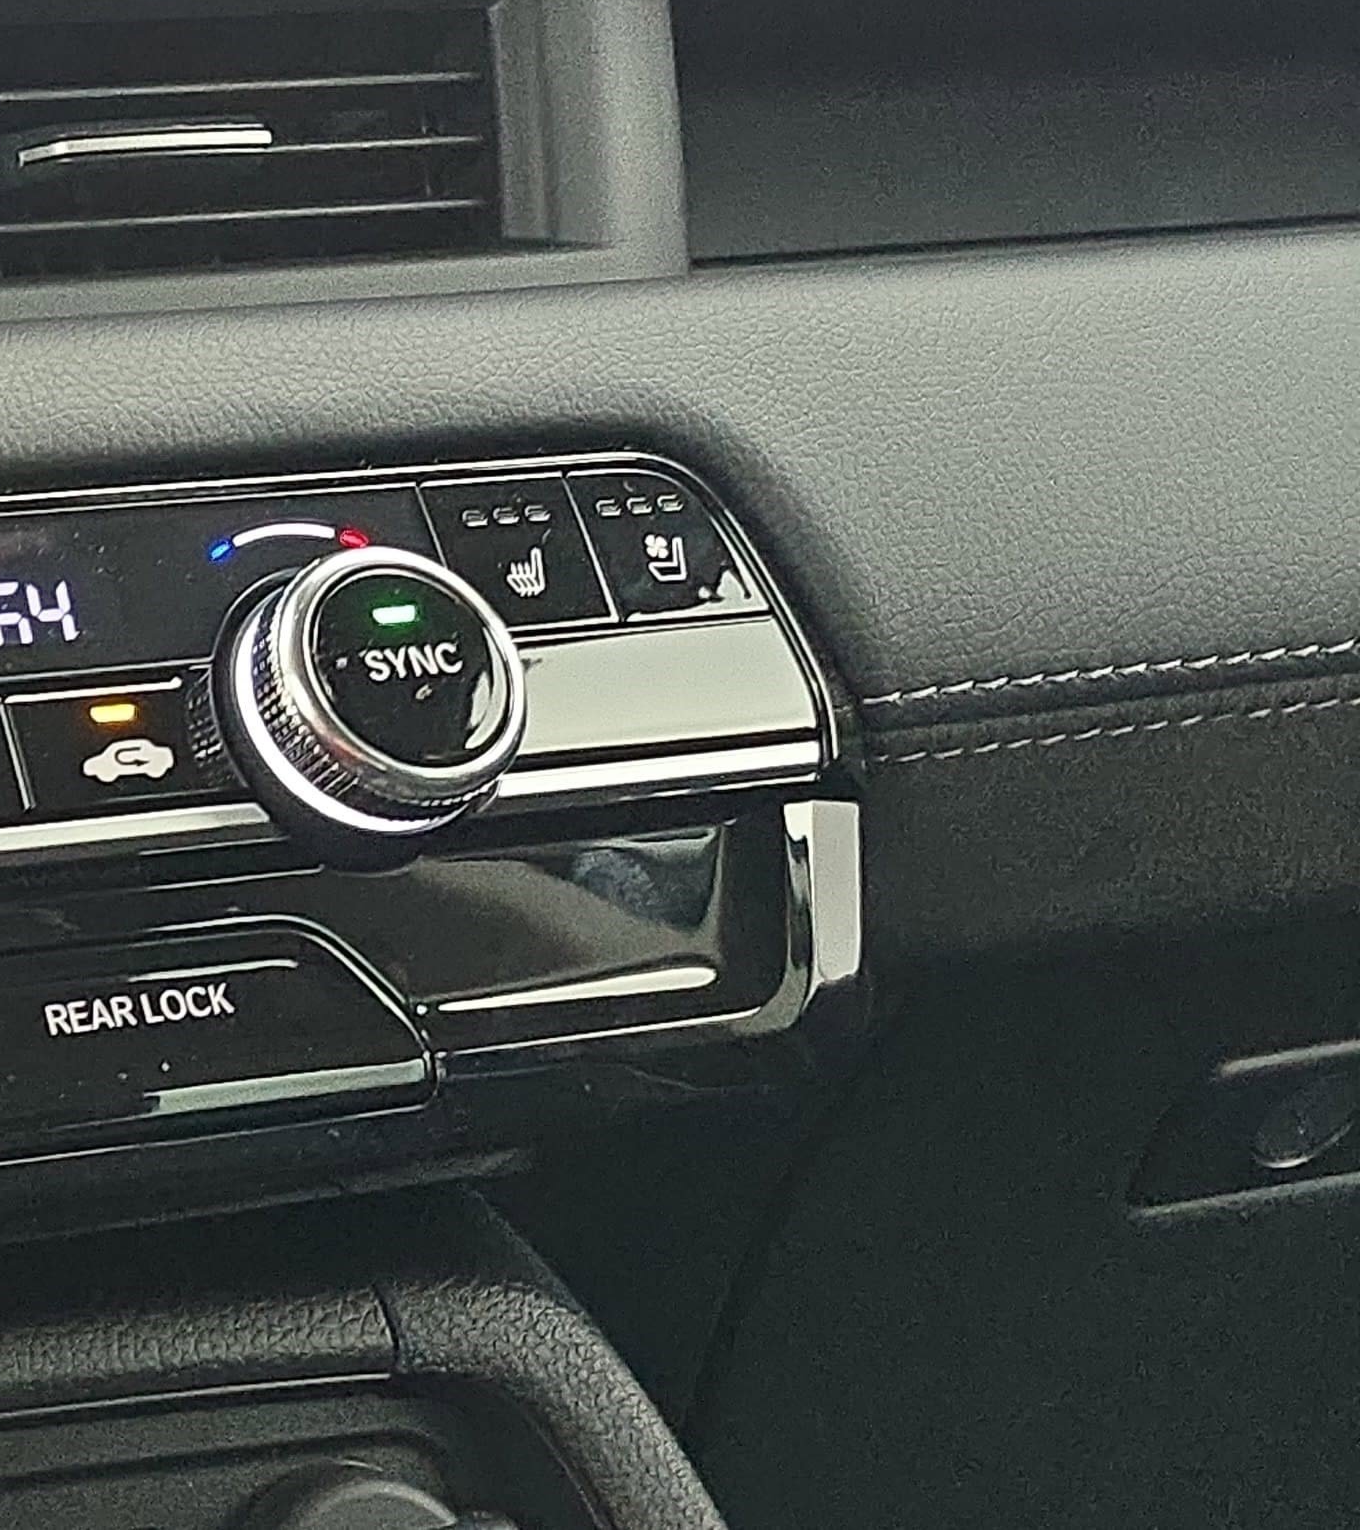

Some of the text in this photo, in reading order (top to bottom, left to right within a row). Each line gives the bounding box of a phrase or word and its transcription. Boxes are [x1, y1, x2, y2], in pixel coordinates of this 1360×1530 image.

[363, 642, 464, 684] SYNC
[44, 982, 235, 1038] REAR LOCK
